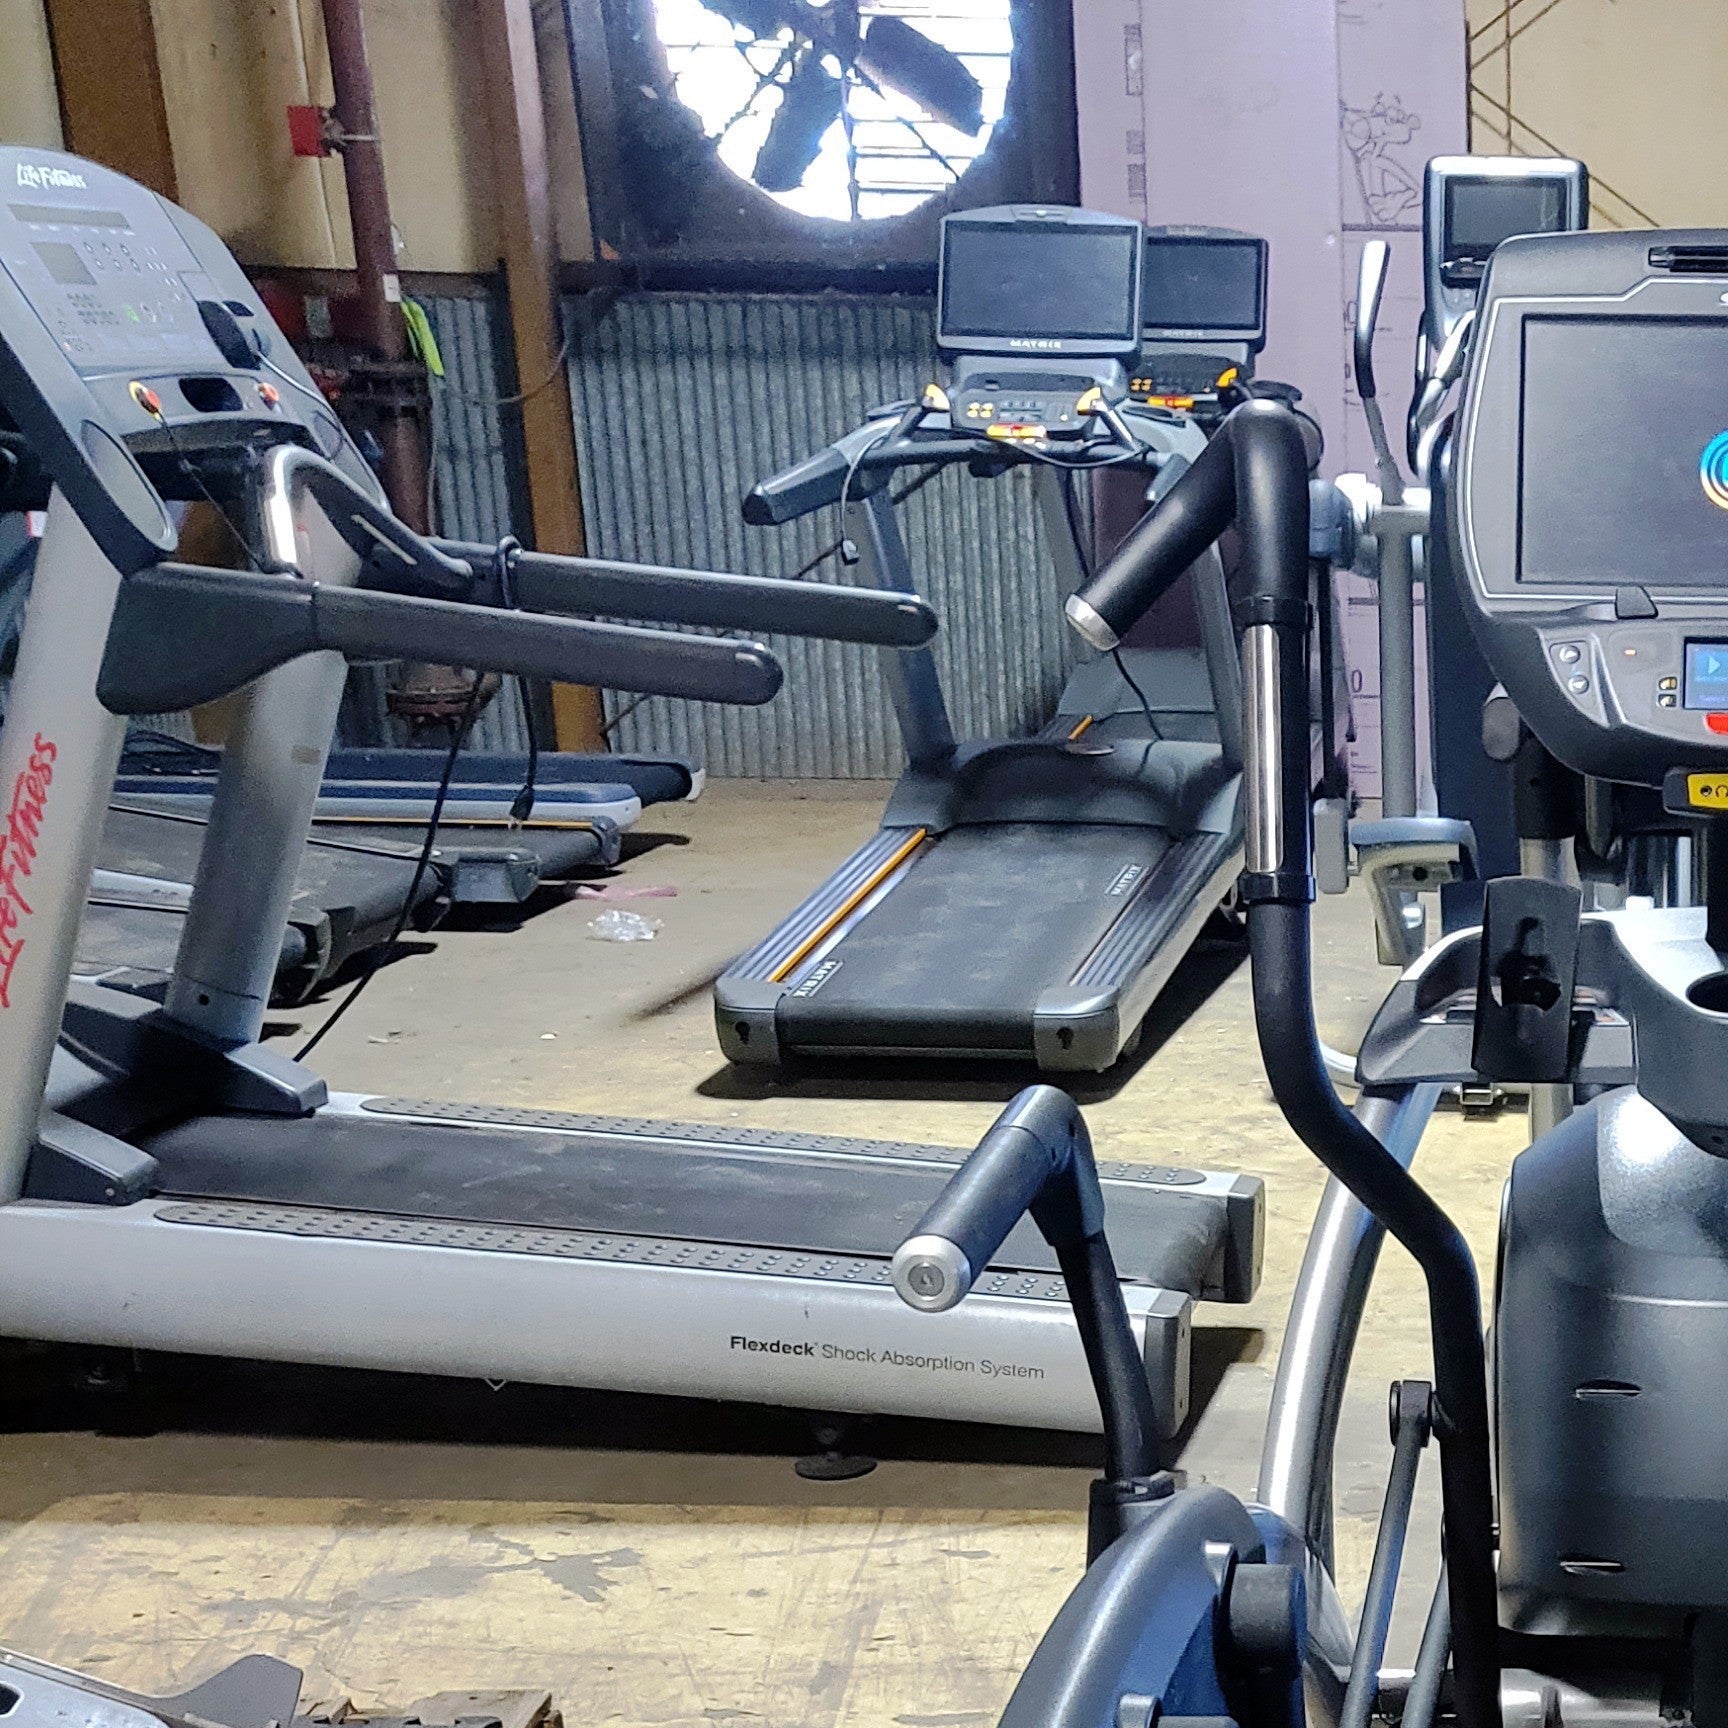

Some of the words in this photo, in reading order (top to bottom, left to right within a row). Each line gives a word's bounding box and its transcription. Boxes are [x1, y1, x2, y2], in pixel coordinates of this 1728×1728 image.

[792, 961, 837, 998] MATRIX
[822, 1343, 877, 1363] Shock
[881, 1350, 975, 1371] Absorption
[980, 1359, 1045, 1379] System
